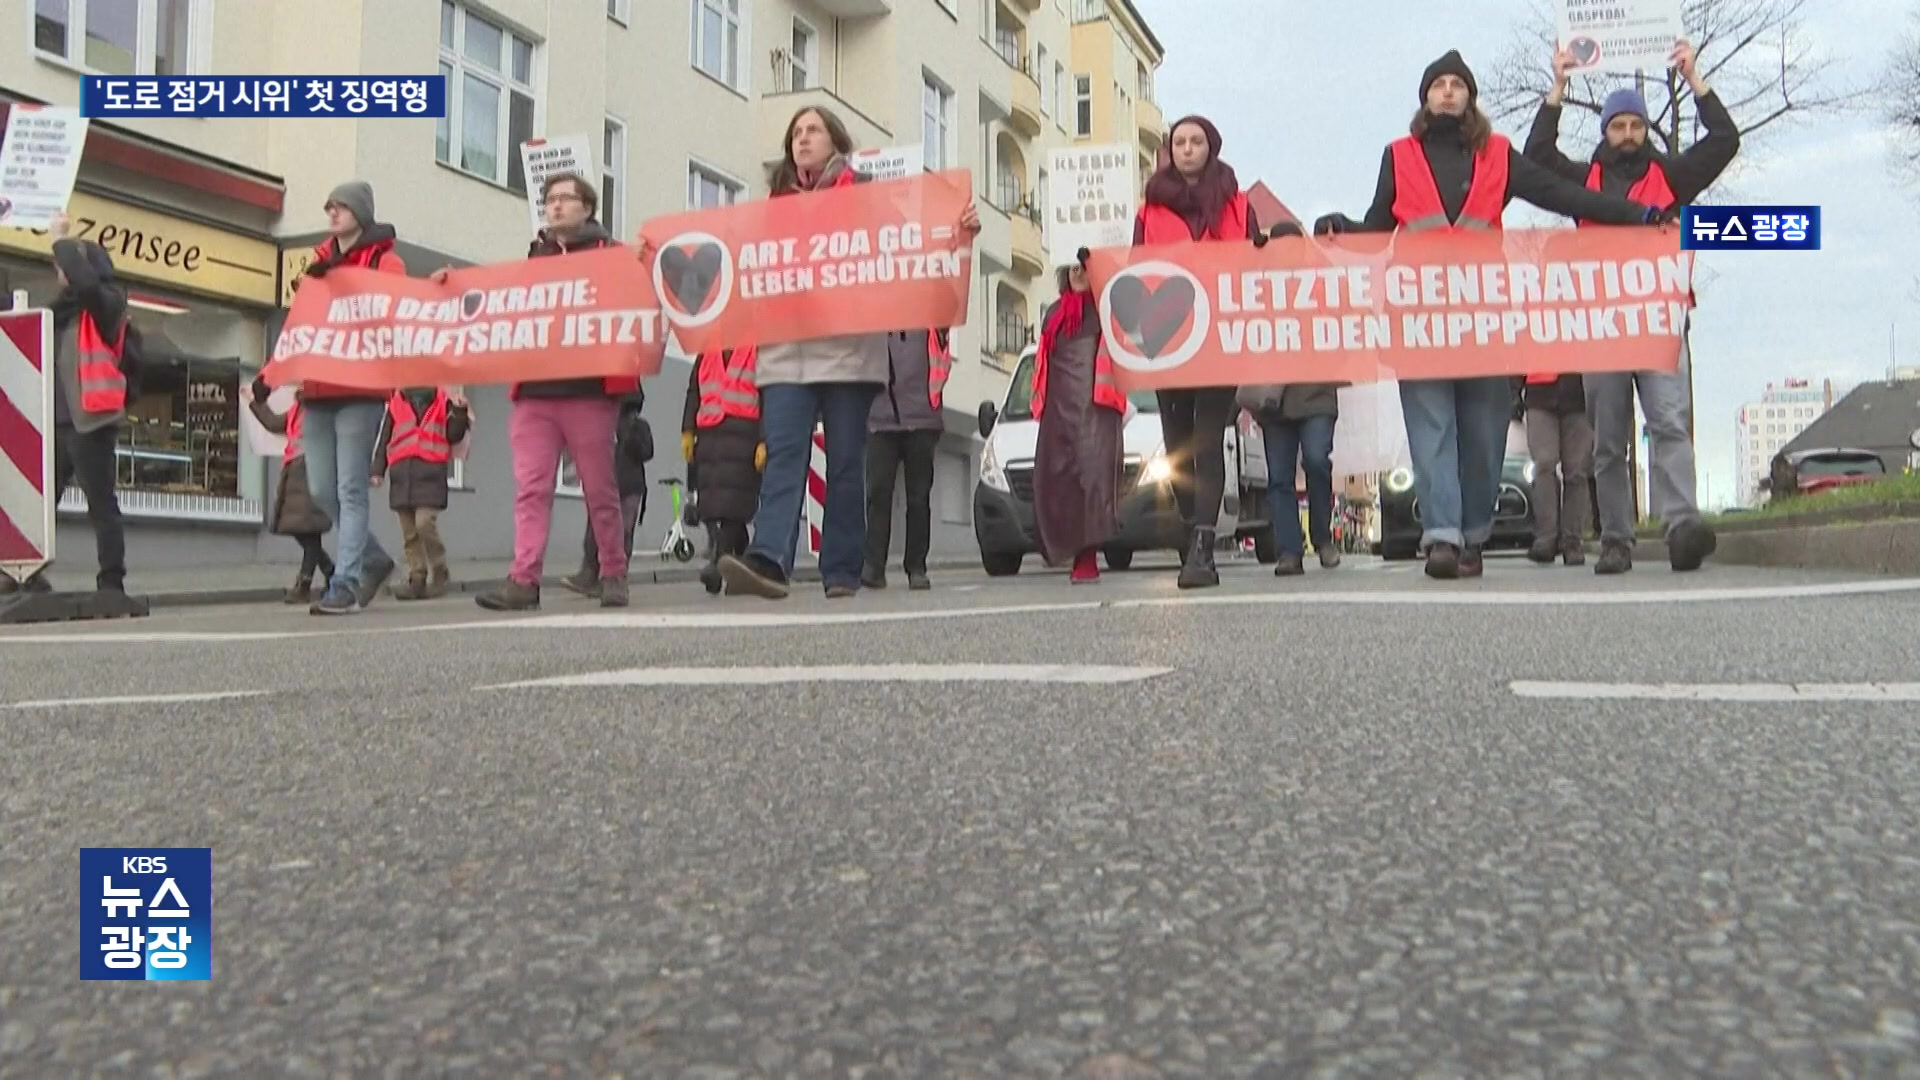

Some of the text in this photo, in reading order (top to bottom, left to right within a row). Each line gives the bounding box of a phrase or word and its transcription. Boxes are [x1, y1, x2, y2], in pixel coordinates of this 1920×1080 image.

[1055, 153, 1126, 171] KLEBEN
[1056, 203, 1128, 224] LEBEN
[738, 237, 801, 271] ART.
[878, 222, 923, 252] GG
[739, 250, 961, 300] LEBEN SCHÜTZEN
[1217, 253, 1690, 314] LETZTE GENERATION
[327, 293, 392, 323] MEHR
[1217, 300, 1688, 353] VOR DEN KIPPPUNKTEN
[273, 313, 550, 362] GESELLSCHAFTSRAT
